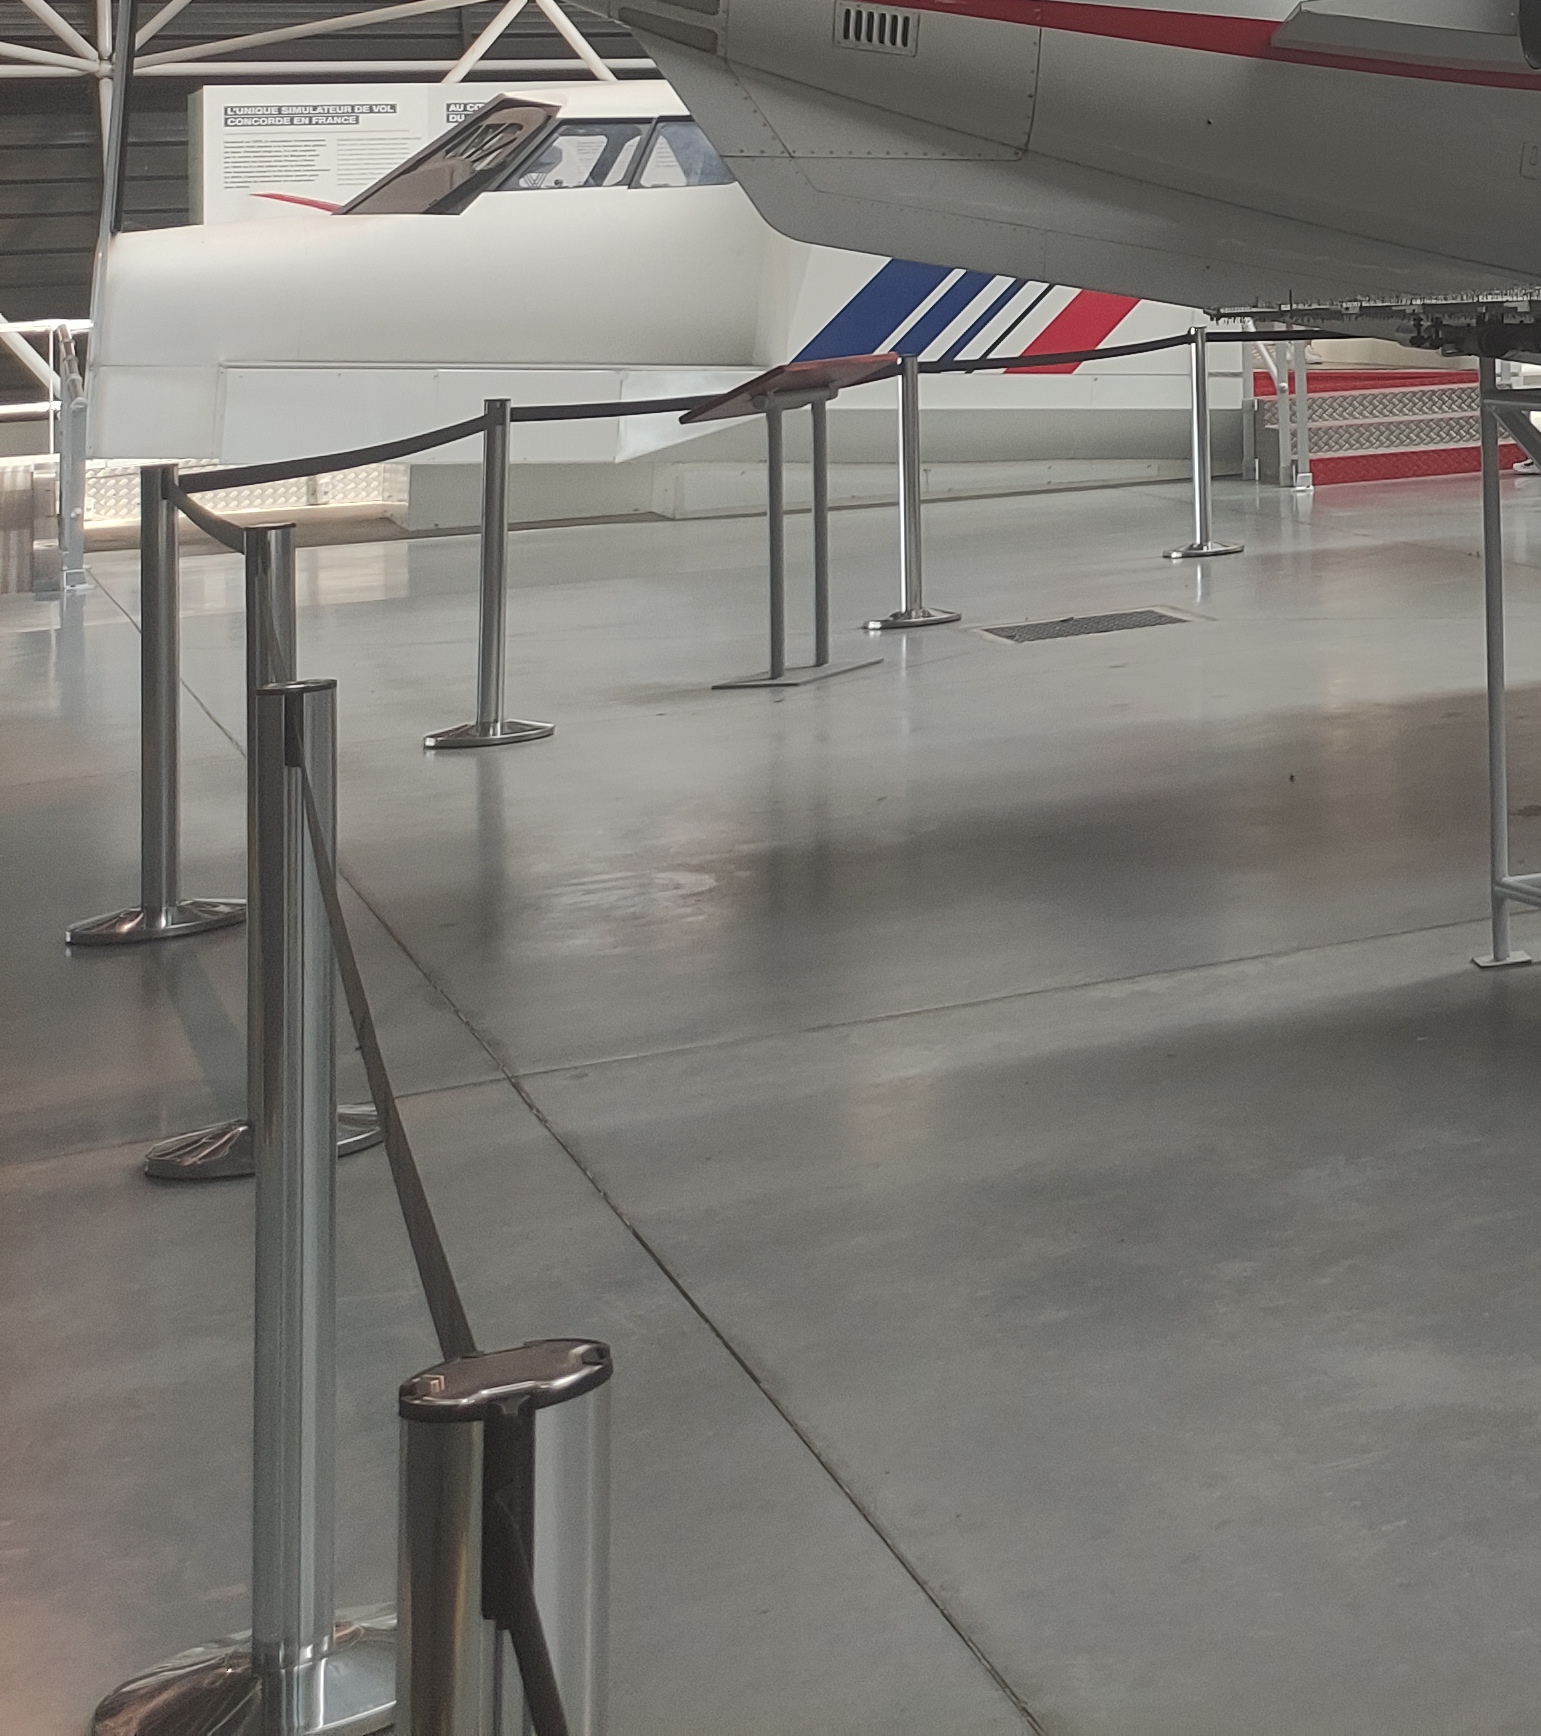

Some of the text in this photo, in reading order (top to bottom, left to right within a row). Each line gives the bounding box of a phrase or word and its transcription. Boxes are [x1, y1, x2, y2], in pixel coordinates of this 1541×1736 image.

[227, 104, 395, 115] L'UNIQUE SIMULATEUR DE VOL
[449, 104, 464, 112] AU
[227, 116, 357, 126] CONCORDE EN FRANCE
[449, 115, 465, 123] DU
